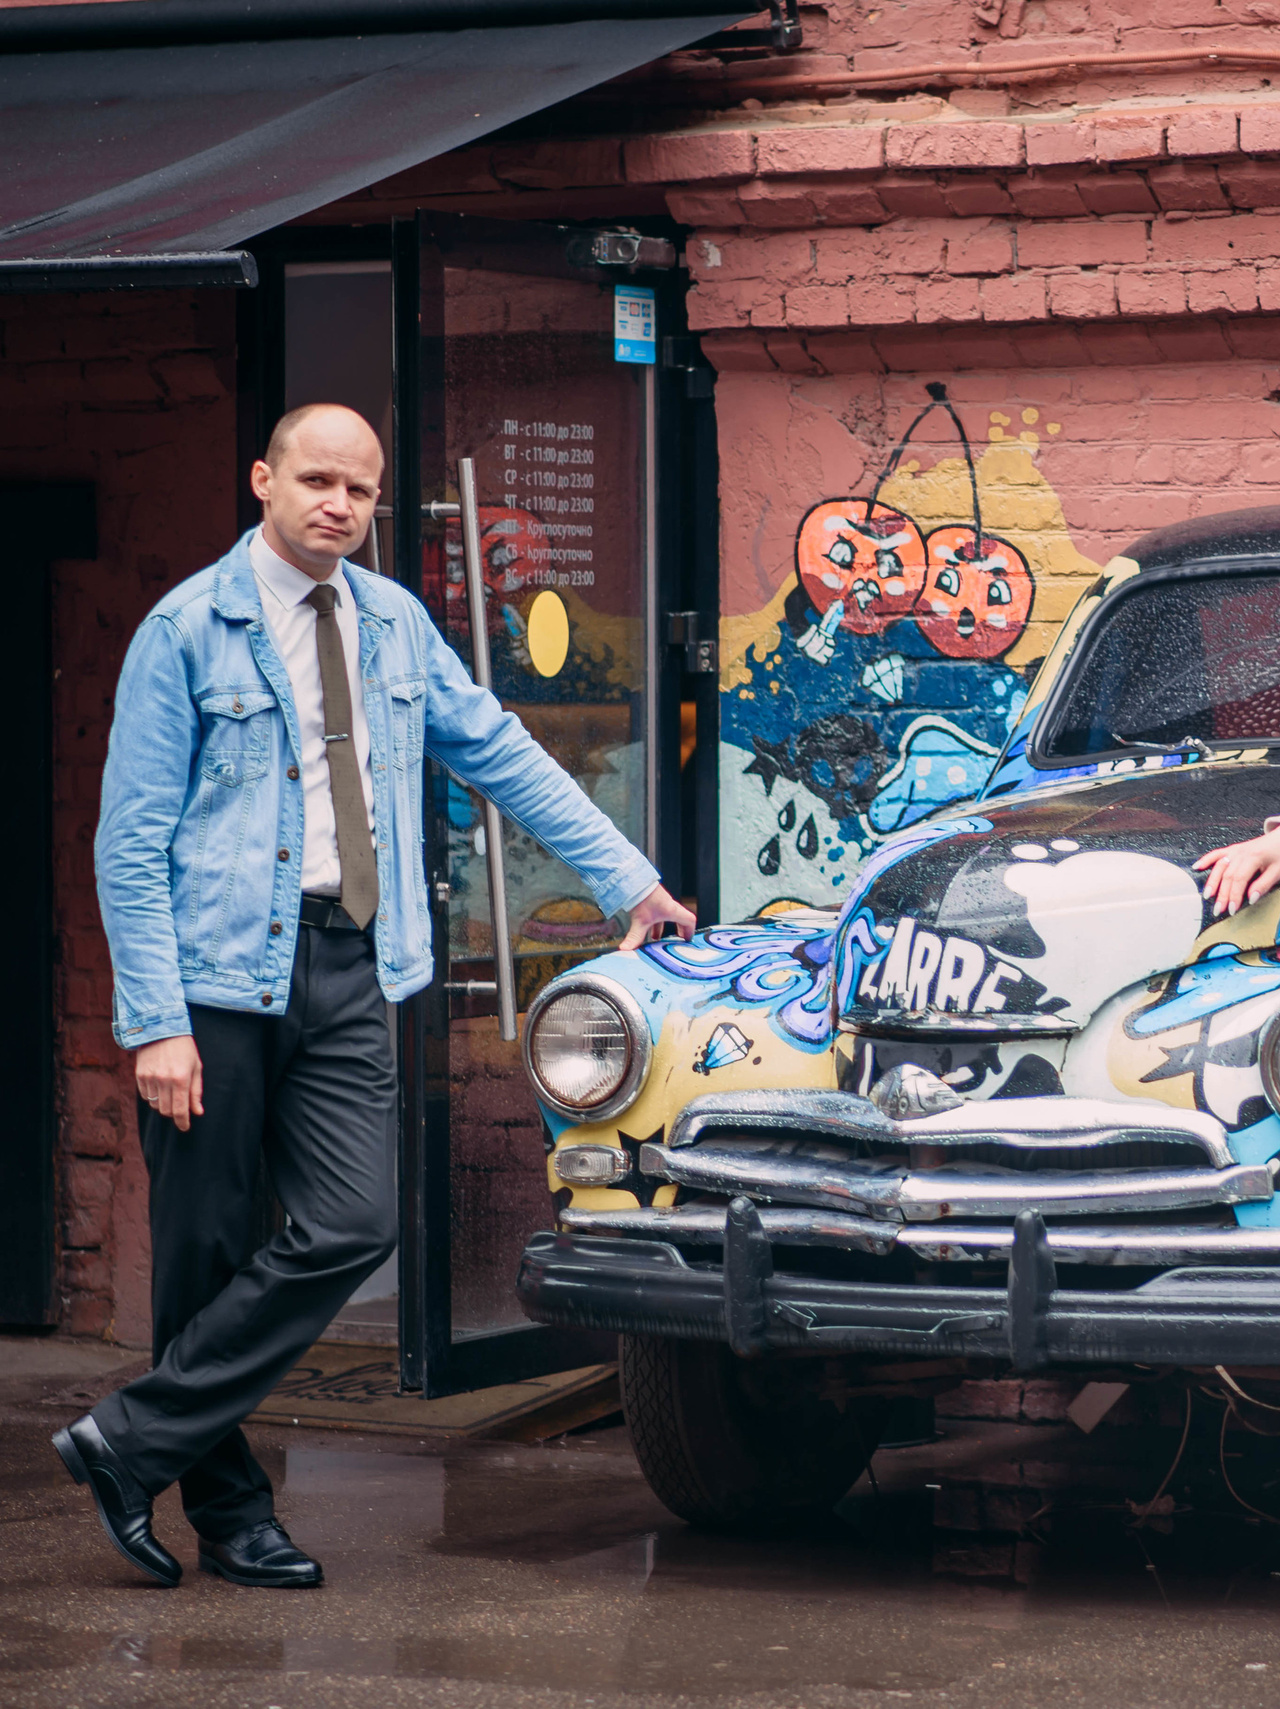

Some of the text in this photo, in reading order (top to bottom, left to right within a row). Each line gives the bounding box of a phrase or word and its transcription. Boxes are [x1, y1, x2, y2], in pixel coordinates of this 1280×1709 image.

[504, 419, 518, 436] ПН
[533, 422, 556, 438] 11:00
[557, 427, 569, 441] до
[570, 424, 594, 440] 23:00
[504, 444, 516, 460] ВТ
[533, 447, 556, 462] 11:00
[557, 451, 569, 466] до
[570, 448, 594, 465] 23:00
[505, 469, 517, 485] СР
[533, 471, 556, 487] 11:00
[557, 475, 569, 490] до
[570, 473, 594, 489] 23:00
[505, 494, 517, 509] ЧТ
[533, 496, 556, 511] 11:00
[557, 500, 569, 514] до
[570, 497, 594, 513] 23:00
[527, 520, 593, 539] Круглосуточно
[505, 543, 518, 559] СБ
[505, 568, 518, 584] ВС
[534, 569, 556, 585] 11:00
[558, 573, 569, 587] до
[571, 570, 595, 586] 23:00
